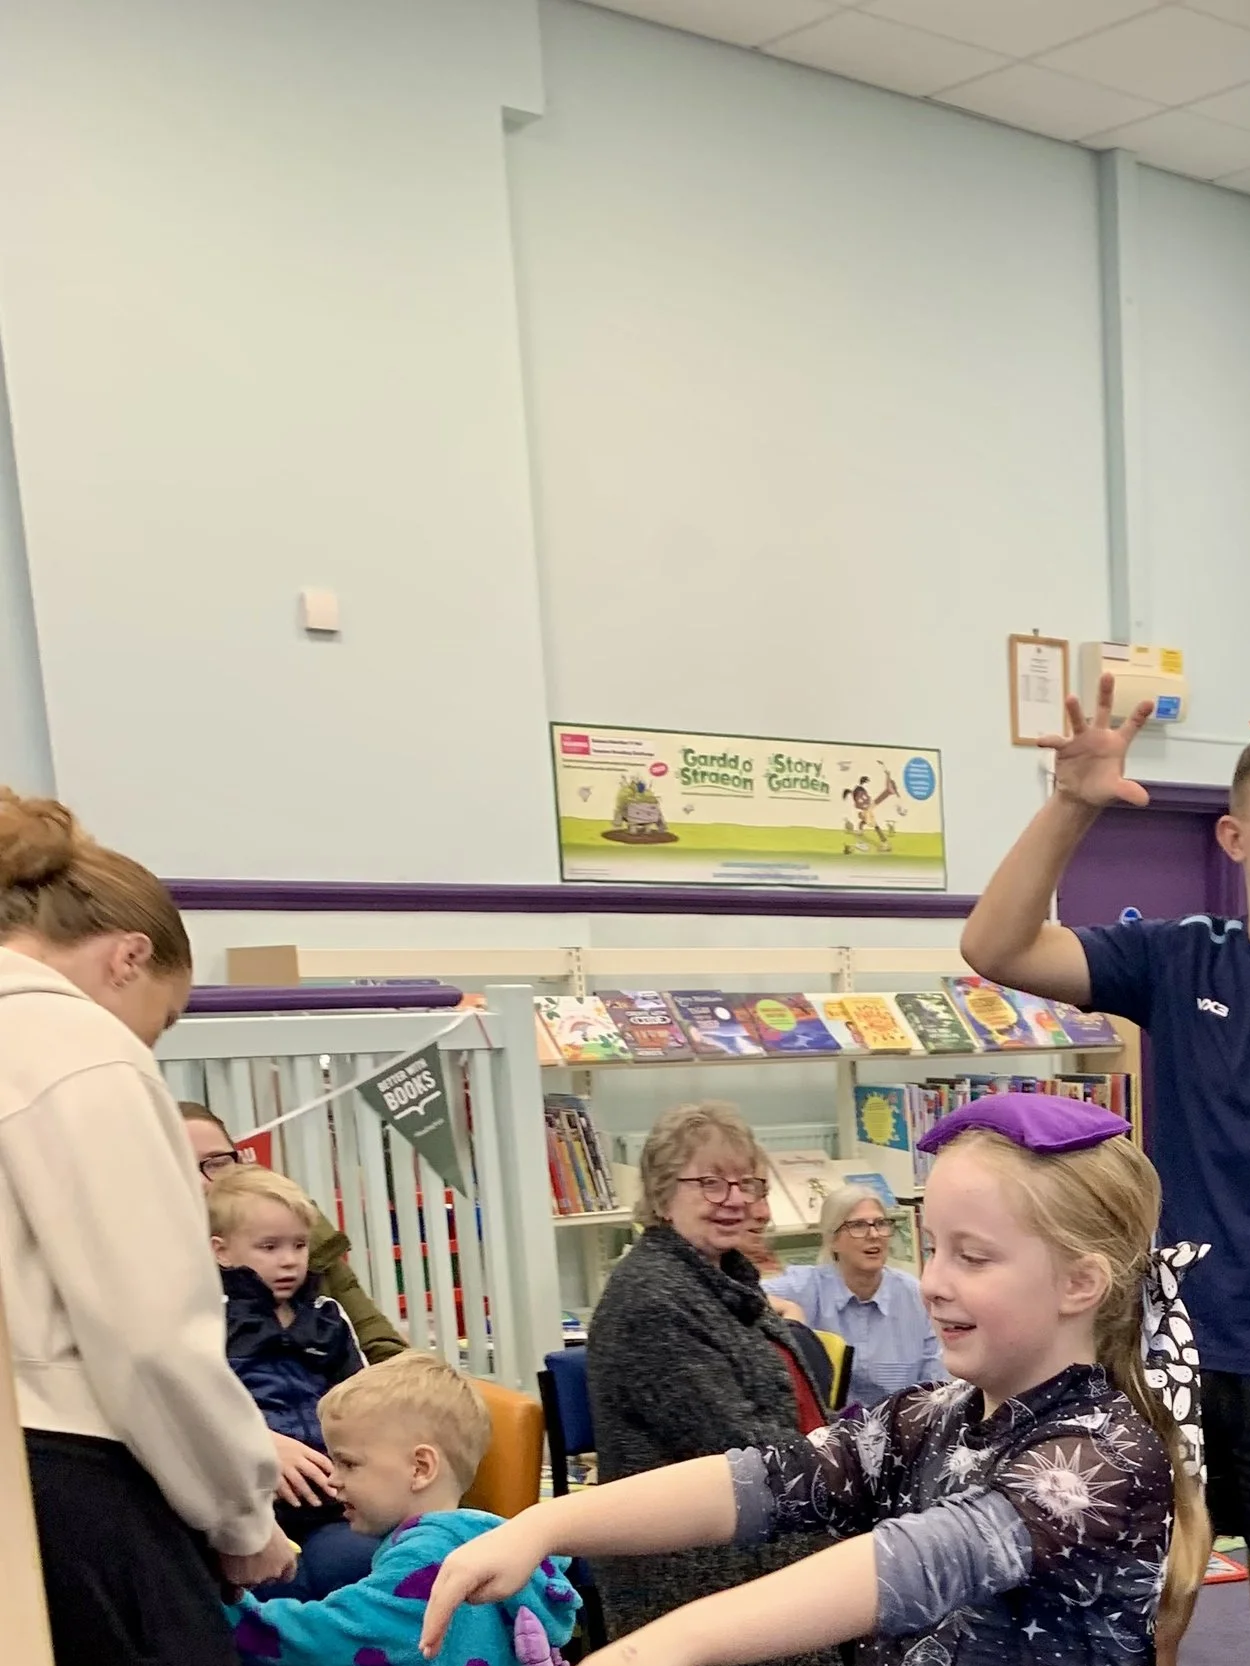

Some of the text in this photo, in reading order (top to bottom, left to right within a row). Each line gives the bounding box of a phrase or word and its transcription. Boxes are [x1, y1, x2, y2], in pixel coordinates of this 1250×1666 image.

[682, 748, 740, 769] Gardd
[773, 753, 823, 778] Story
[680, 767, 754, 791] Straeon
[767, 772, 830, 794] Garden
[377, 1070, 408, 1093] BETTER
[383, 1070, 436, 1111] BOOKS
